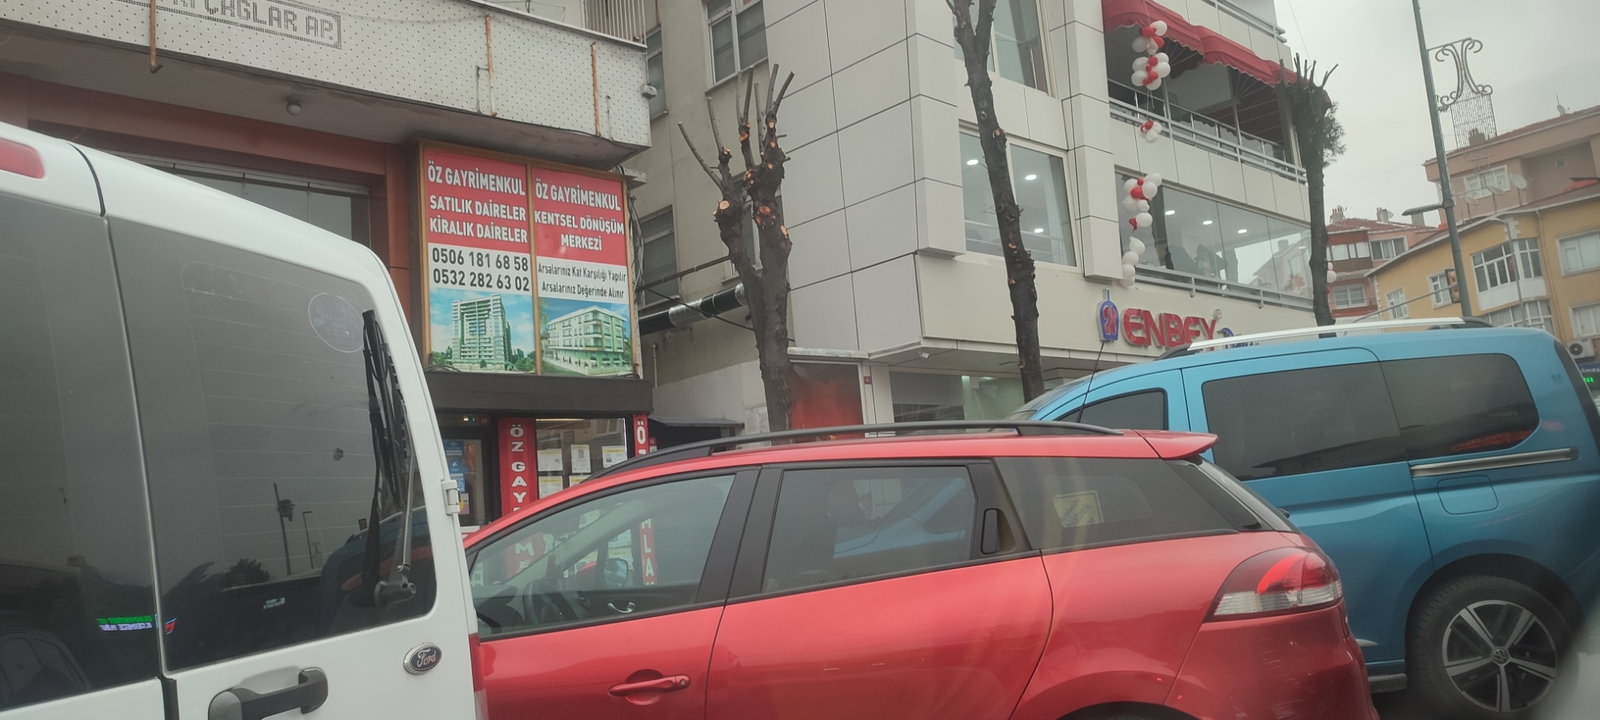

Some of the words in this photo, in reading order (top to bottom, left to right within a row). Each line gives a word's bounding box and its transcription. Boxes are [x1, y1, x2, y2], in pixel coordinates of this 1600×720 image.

[305, 15, 334, 41] AP.
[427, 160, 443, 184] ÖZ
[445, 167, 526, 196] GAYRİMENKUL
[535, 177, 549, 200] ÖZ
[550, 184, 622, 211] GAYRİMENKUL
[429, 194, 473, 215] SATILIK
[475, 199, 527, 221] DAİRELER
[429, 215, 475, 238] KİRALIK
[476, 221, 528, 243] DAİRELER
[534, 210, 579, 229] KENTSEL
[580, 214, 625, 235] DÖNÜŞÜM
[560, 233, 603, 251] MERKEZİ
[432, 247, 465, 266] 0506
[469, 251, 490, 268] 181
[495, 254, 511, 270] 68
[513, 256, 529, 272] 58
[538, 262, 571, 276] Arsalarınız
[572, 266, 582, 277] Kat
[583, 267, 607, 282] Karşılığı
[608, 270, 627, 283] Yapılır
[433, 268, 466, 286] 0532
[469, 271, 493, 289] 282
[496, 274, 512, 290] 63
[514, 276, 530, 291] 02
[541, 281, 576, 294] Arsalarınız
[577, 284, 607, 298] Değerinde
[608, 287, 625, 299] Alınır
[509, 424, 525, 453] ÖZ
[510, 461, 528, 513] GAY
